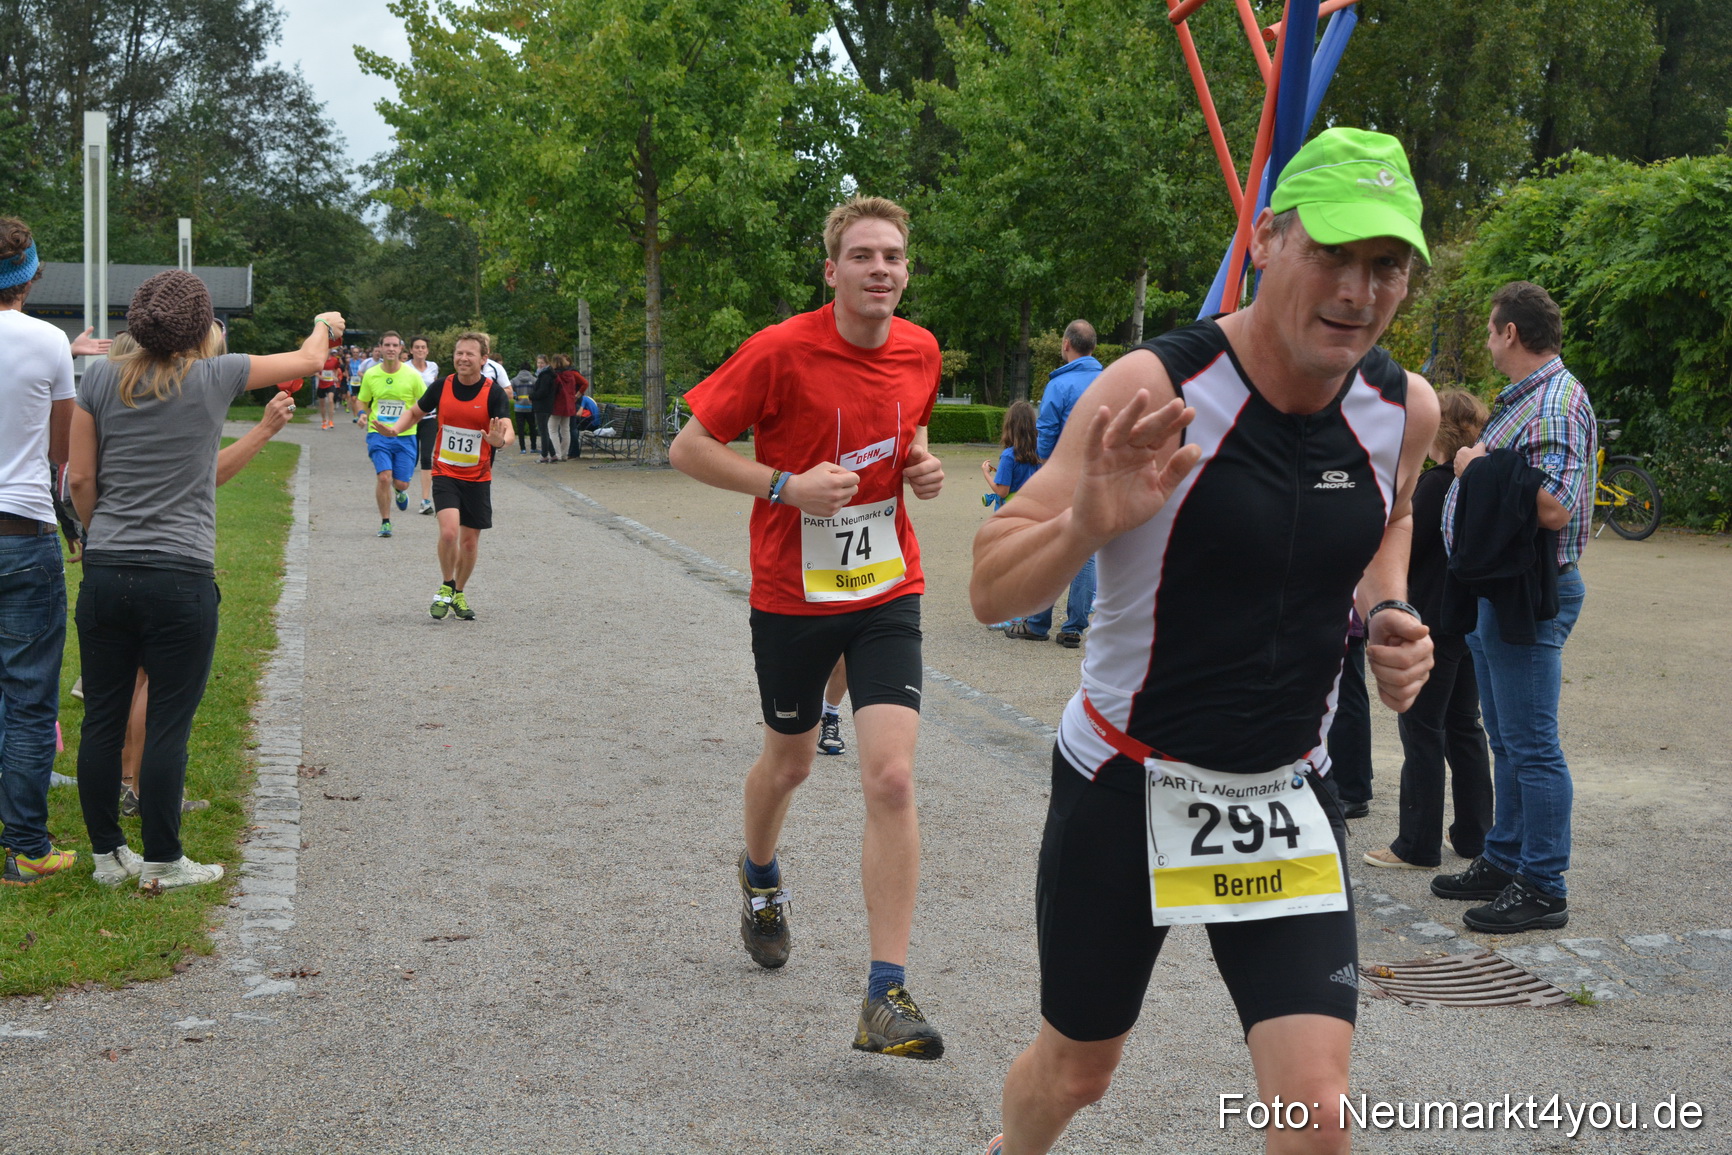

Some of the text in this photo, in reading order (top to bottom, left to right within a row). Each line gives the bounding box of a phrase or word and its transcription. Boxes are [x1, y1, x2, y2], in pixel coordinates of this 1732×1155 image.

[380, 405, 403, 415] 2777
[448, 436, 473, 452] 613
[856, 448, 881, 464] DEHN
[804, 510, 881, 528] PARTL Neumarkt
[835, 526, 871, 566] 74
[836, 572, 876, 588] Simon
[1151, 777, 1287, 798] PARTL Neumarkt
[1187, 801, 1301, 857] 294
[1213, 868, 1283, 897] Bernd
